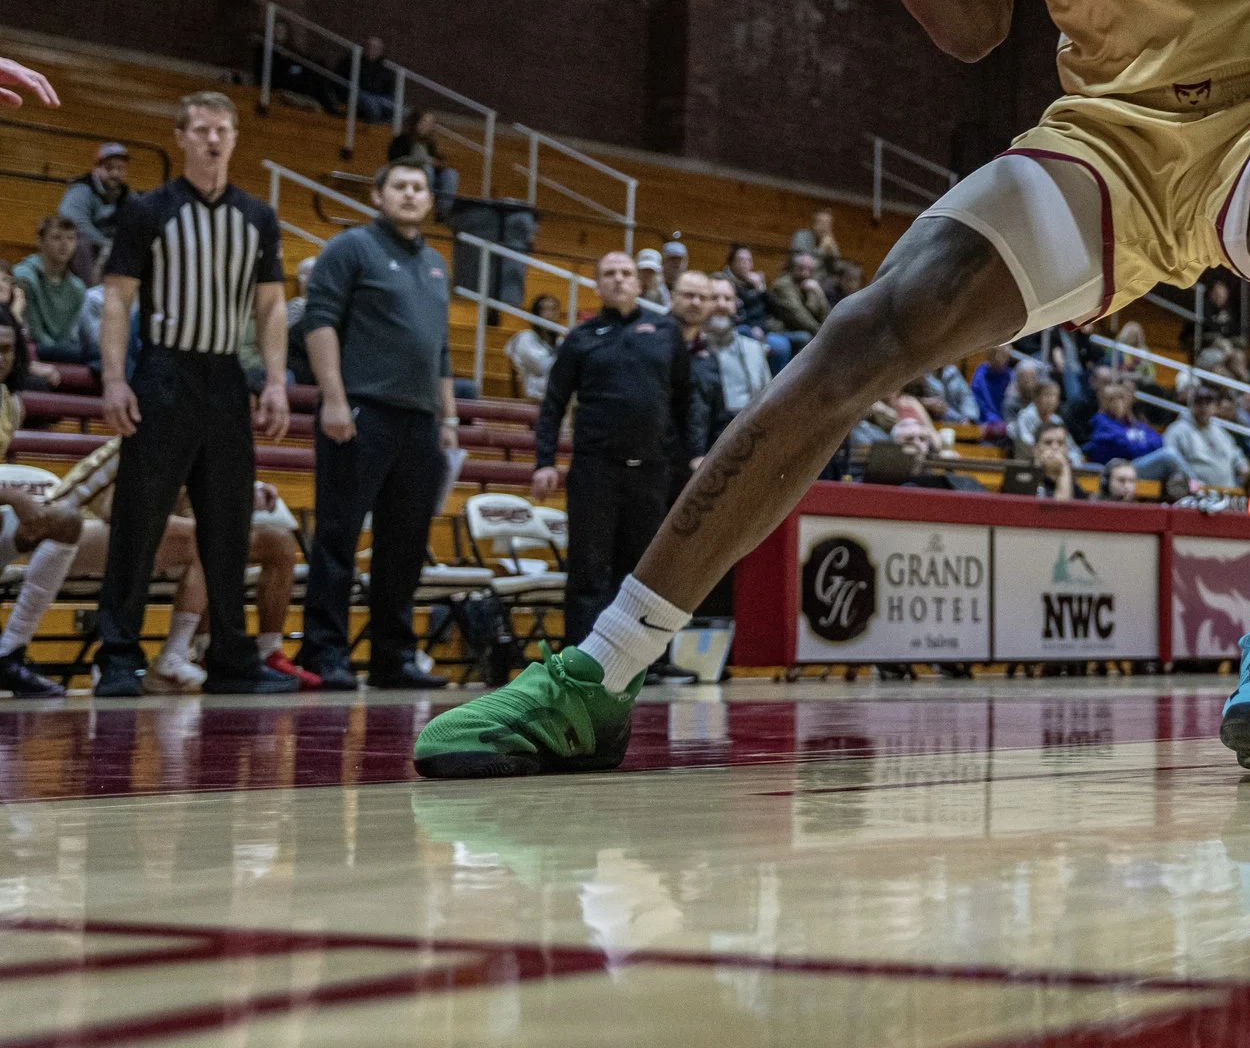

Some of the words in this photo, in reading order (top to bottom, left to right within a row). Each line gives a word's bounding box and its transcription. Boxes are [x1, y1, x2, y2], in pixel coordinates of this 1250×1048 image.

[885, 553, 983, 588] GRAND
[887, 597, 981, 623] HOTEL
[1043, 593, 1114, 639] NWC
